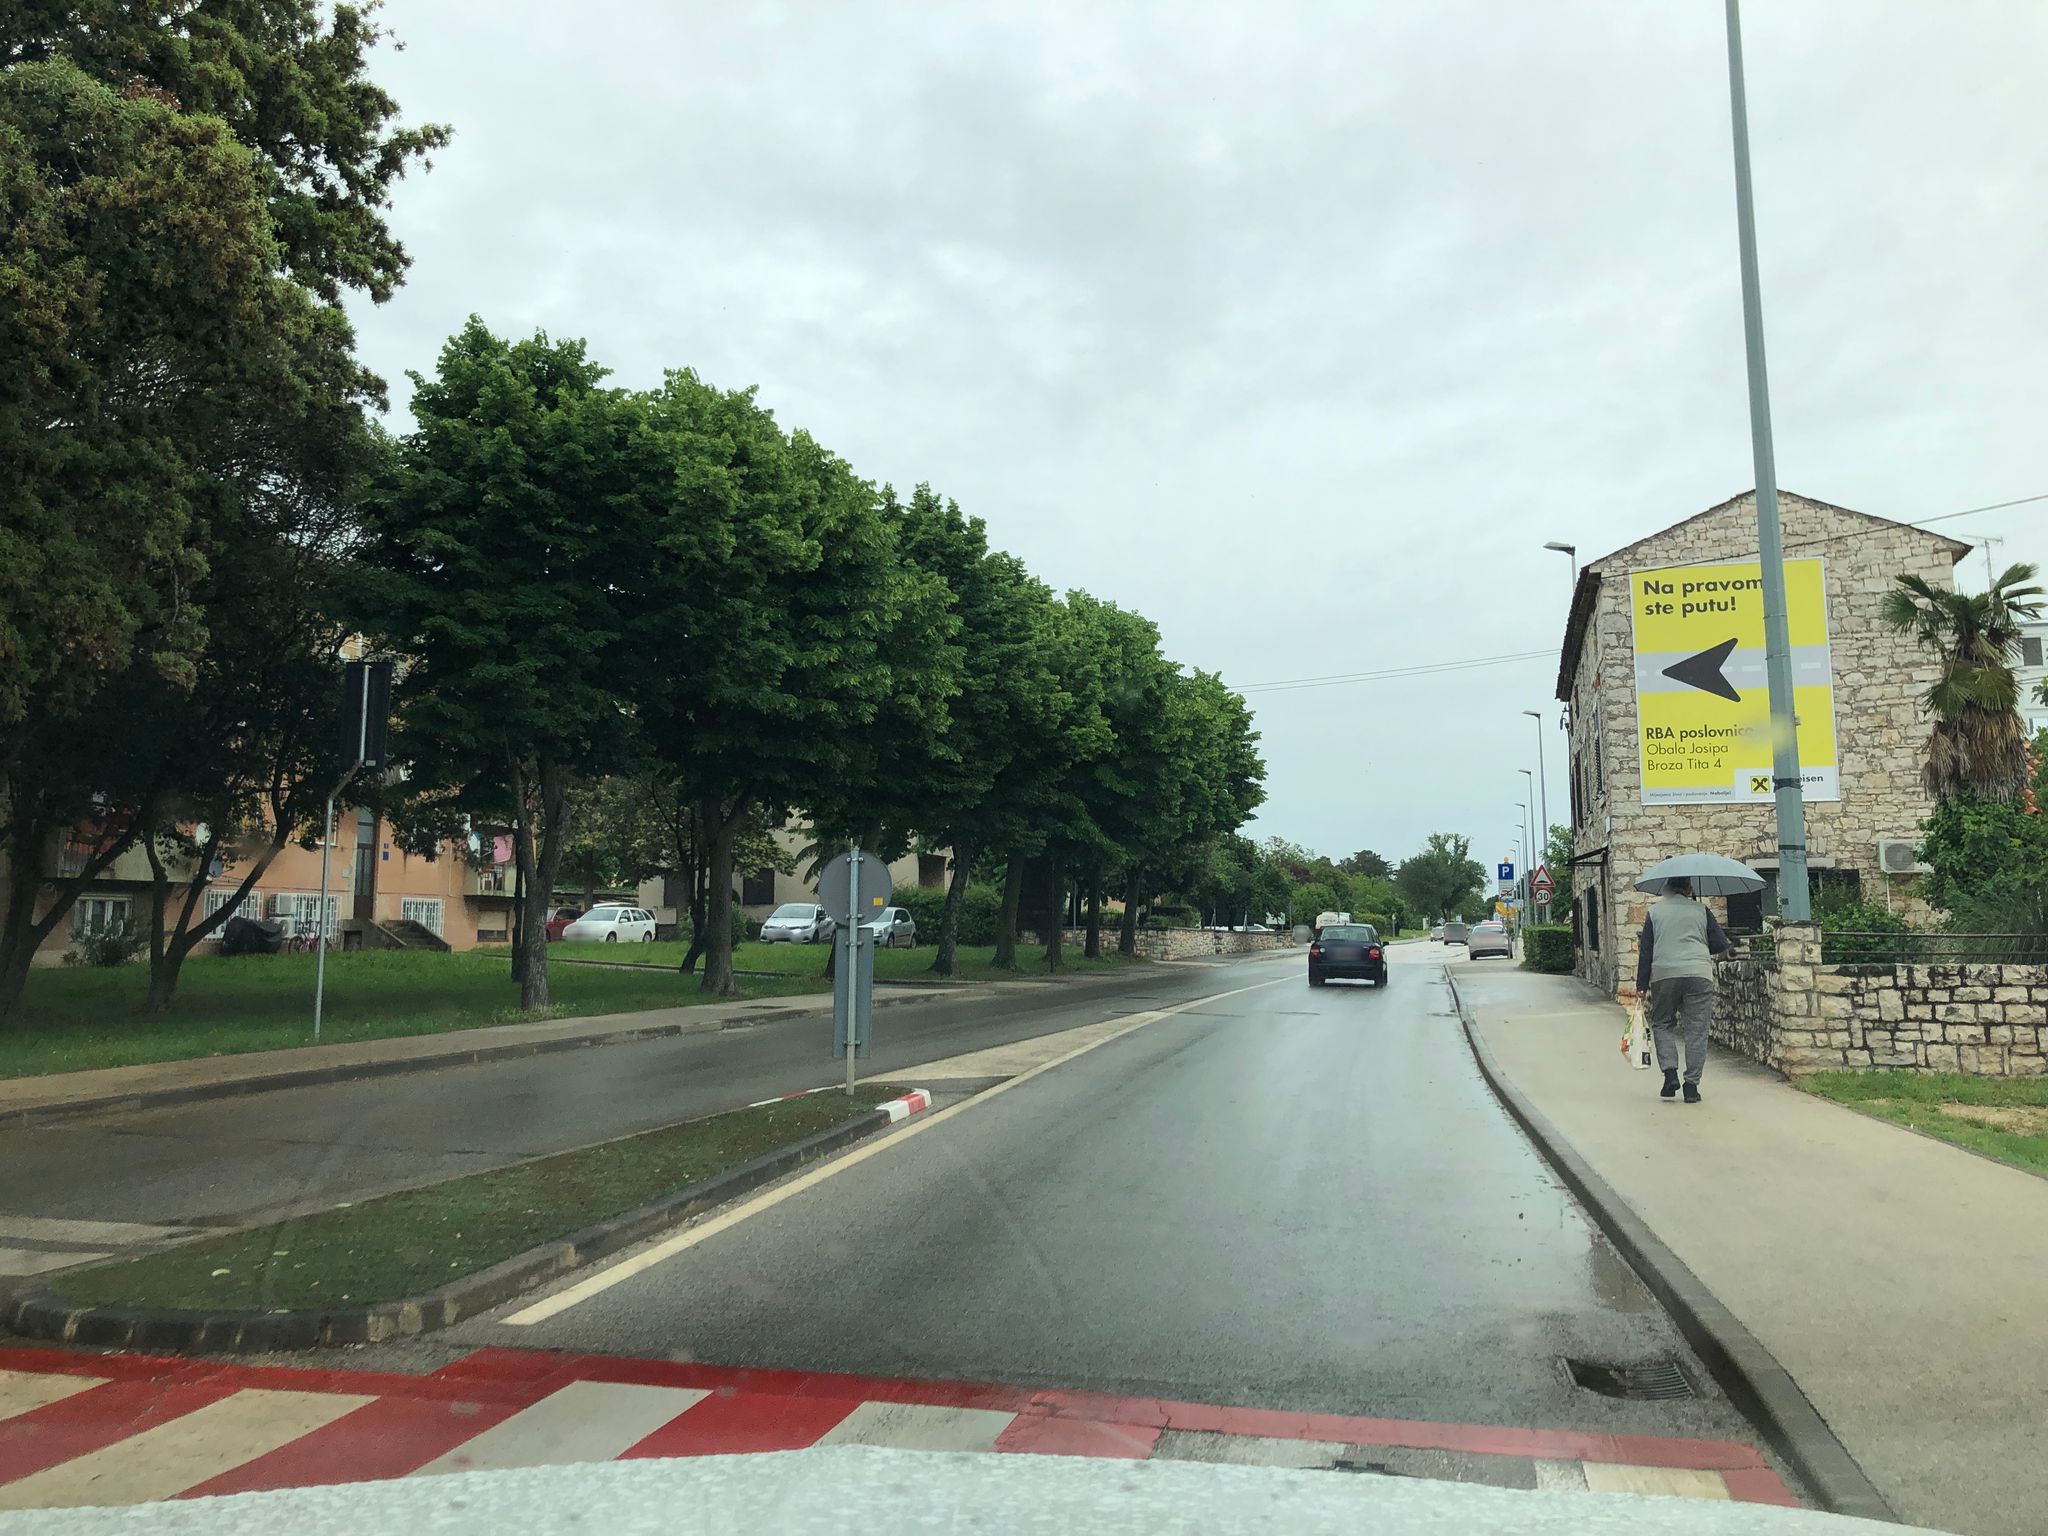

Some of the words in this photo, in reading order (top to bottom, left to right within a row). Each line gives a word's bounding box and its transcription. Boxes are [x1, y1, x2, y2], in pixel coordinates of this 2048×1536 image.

[1643, 580, 1674, 595] Na
[1682, 578, 1763, 598] pravom
[1645, 601, 1674, 615] ste
[1681, 596, 1737, 618] putu!
[1646, 726, 1675, 740] RBA
[1646, 742, 1686, 756] Obala
[1690, 742, 1729, 757] Josipa
[1647, 759, 1683, 771] Broza
[1687, 758, 1709, 770] Tita
[1713, 758, 1722, 769] 4
[1502, 866, 1510, 877] P
[1537, 892, 1549, 901] 30
